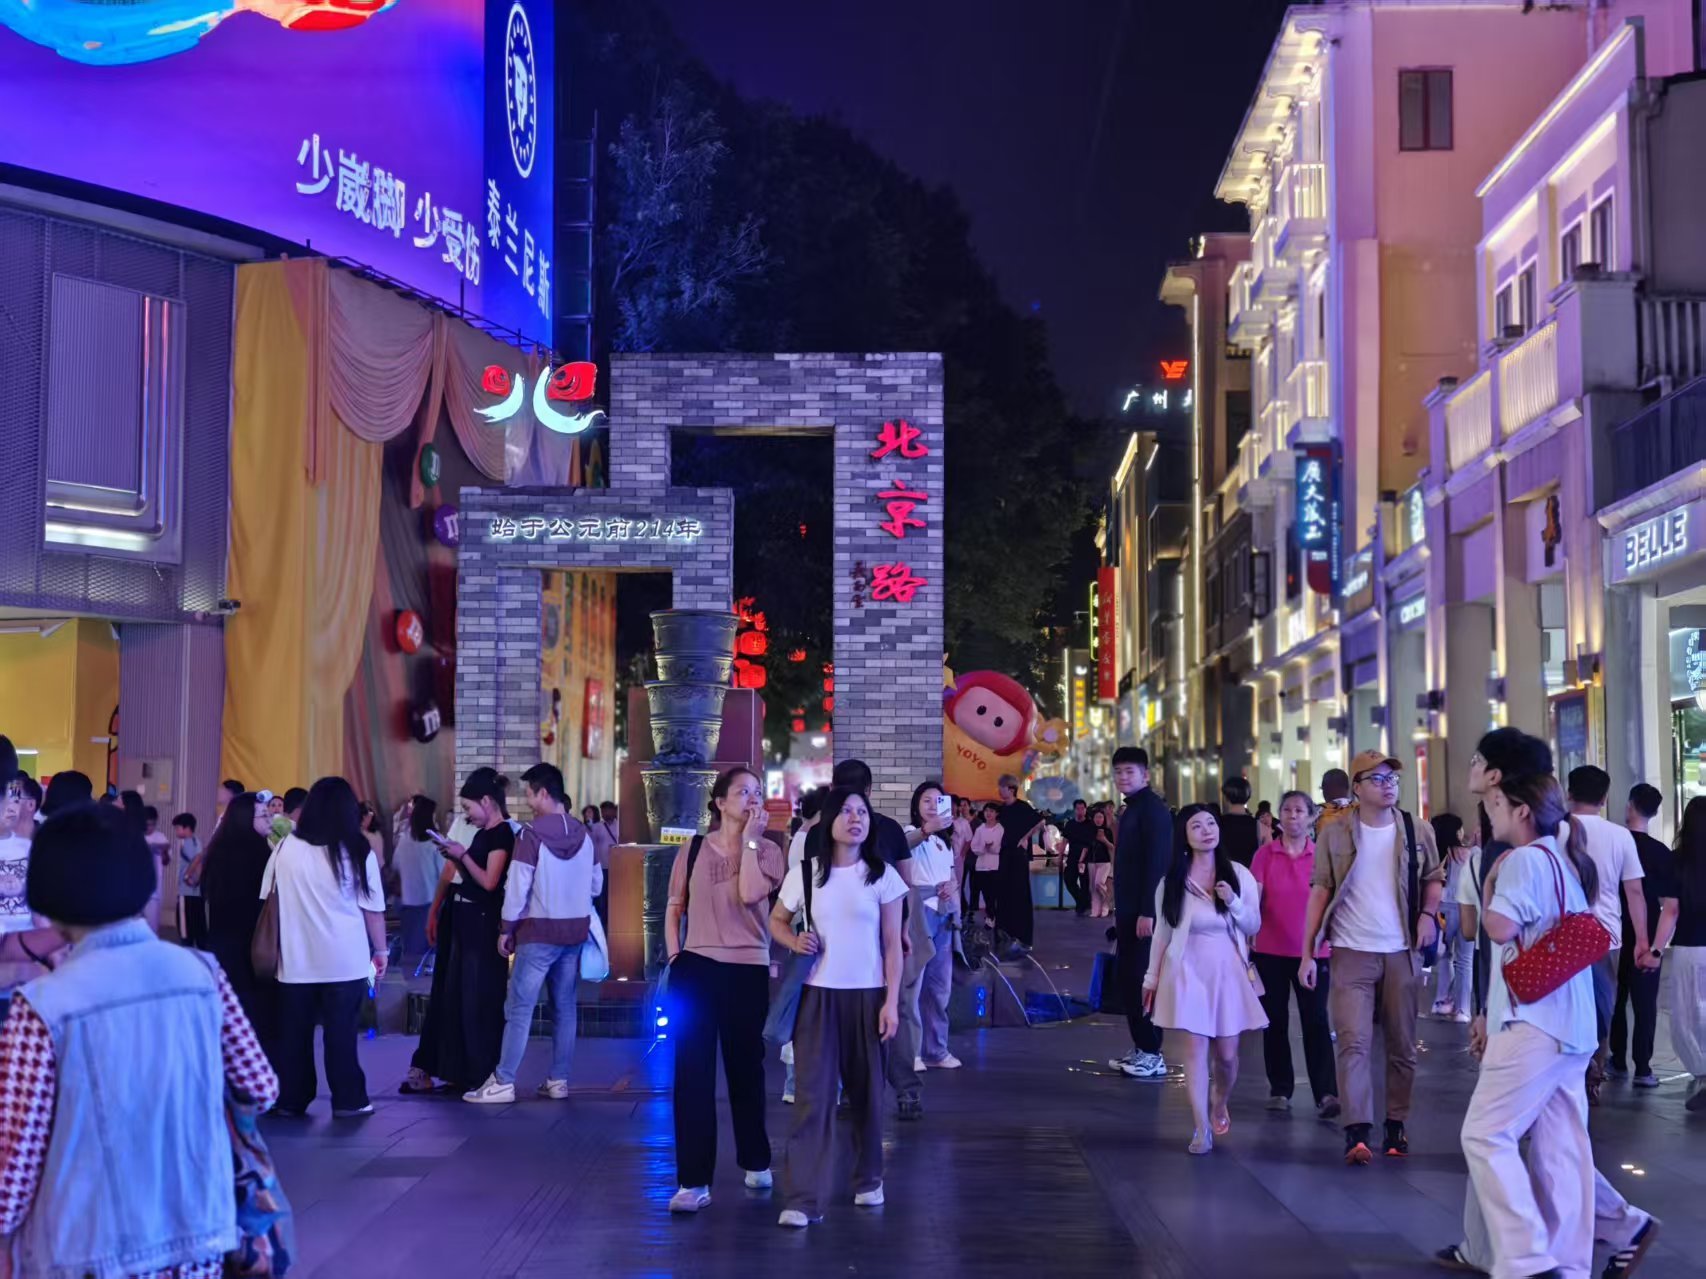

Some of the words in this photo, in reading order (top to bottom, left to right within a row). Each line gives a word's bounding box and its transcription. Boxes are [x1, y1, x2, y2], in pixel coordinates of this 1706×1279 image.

[413, 192, 480, 286] 少受伤
[487, 178, 550, 320] 泰兰尼斯
[491, 517, 702, 541] 始于公元前214年
[869, 418, 929, 603] 北京路
[1625, 511, 1687, 569] BELLE
[956, 744, 986, 770] YOYO
